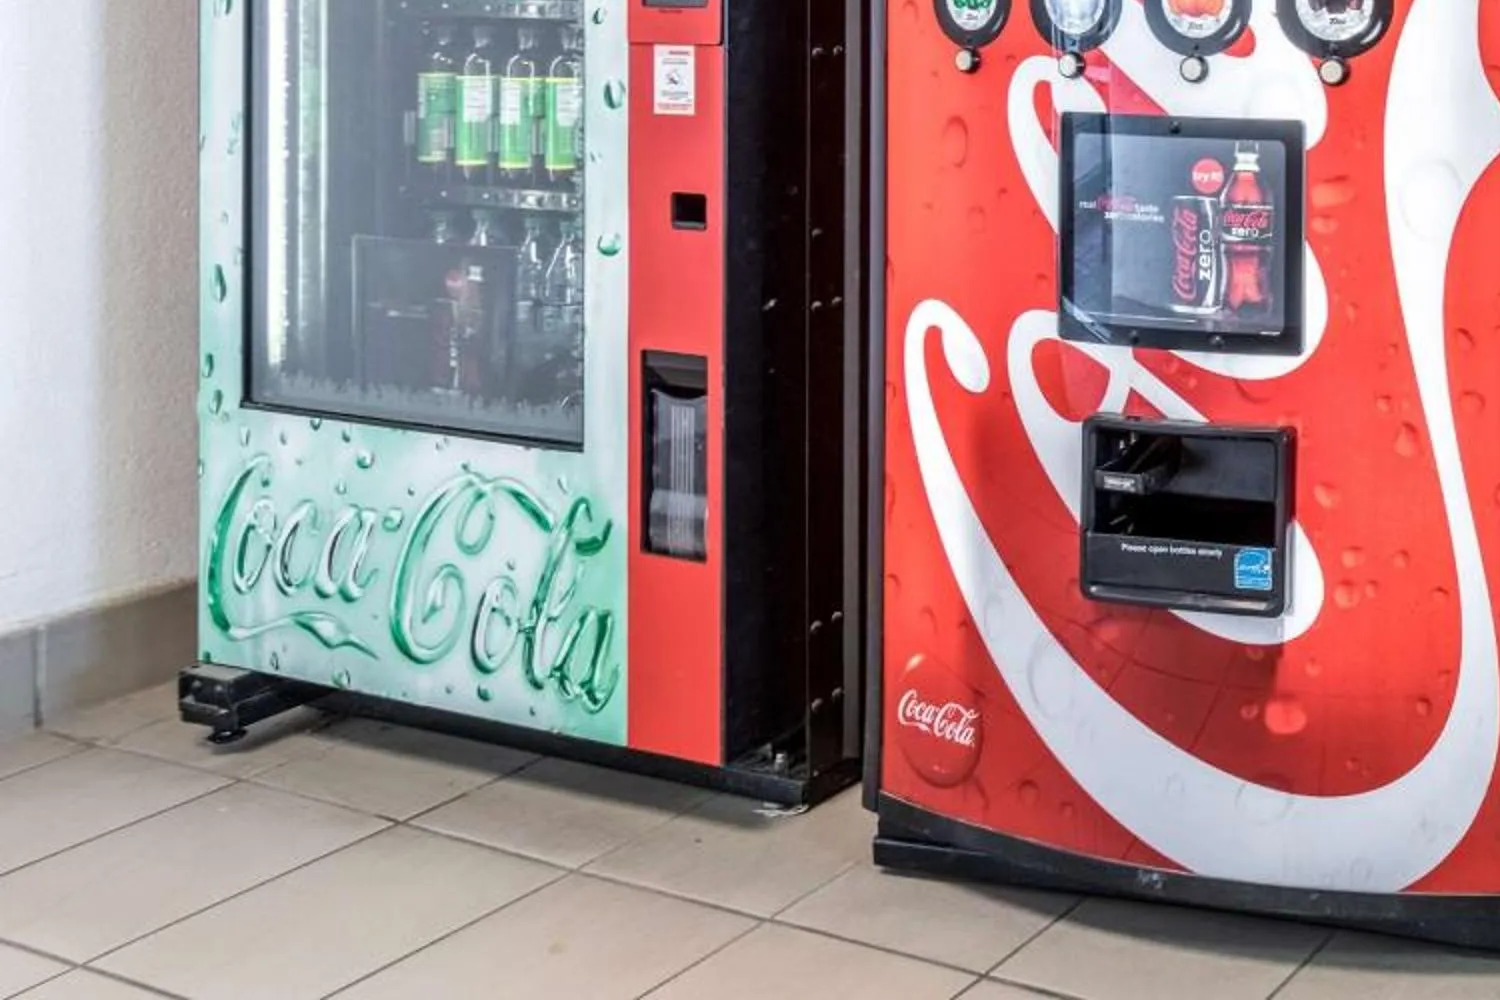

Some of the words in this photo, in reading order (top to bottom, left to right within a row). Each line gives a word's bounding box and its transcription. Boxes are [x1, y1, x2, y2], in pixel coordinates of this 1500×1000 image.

[1231, 227, 1258, 237] zero
[1199, 229, 1213, 281] zero
[1121, 542, 1146, 553] Please
[1148, 545, 1168, 556] open
[1170, 546, 1196, 556] bottles
